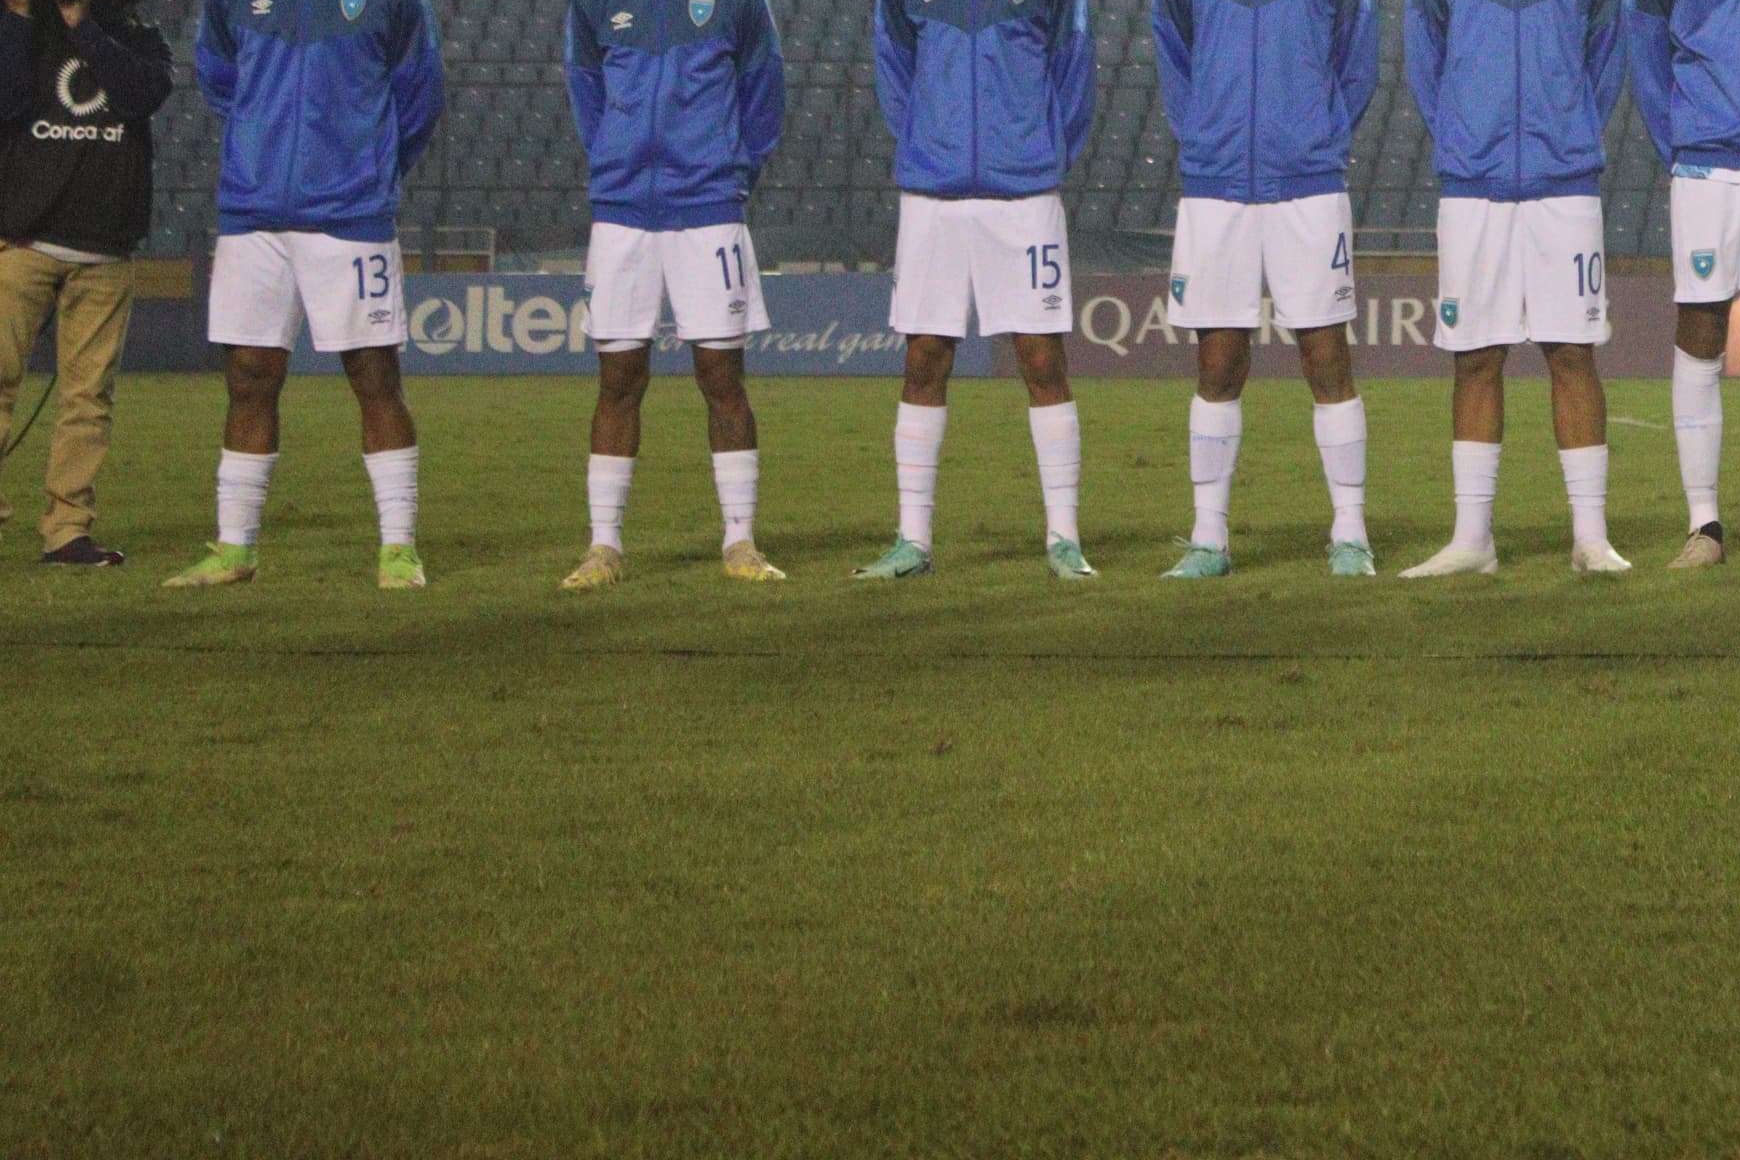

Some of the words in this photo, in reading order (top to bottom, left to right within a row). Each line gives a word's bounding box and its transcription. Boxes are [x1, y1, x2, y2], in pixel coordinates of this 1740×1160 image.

[31, 120, 124, 141] Concaaf
[352, 253, 389, 300] 13
[715, 243, 745, 290] 11
[1026, 244, 1061, 290] 15
[1330, 231, 1350, 276] 4
[1573, 251, 1602, 297] 10
